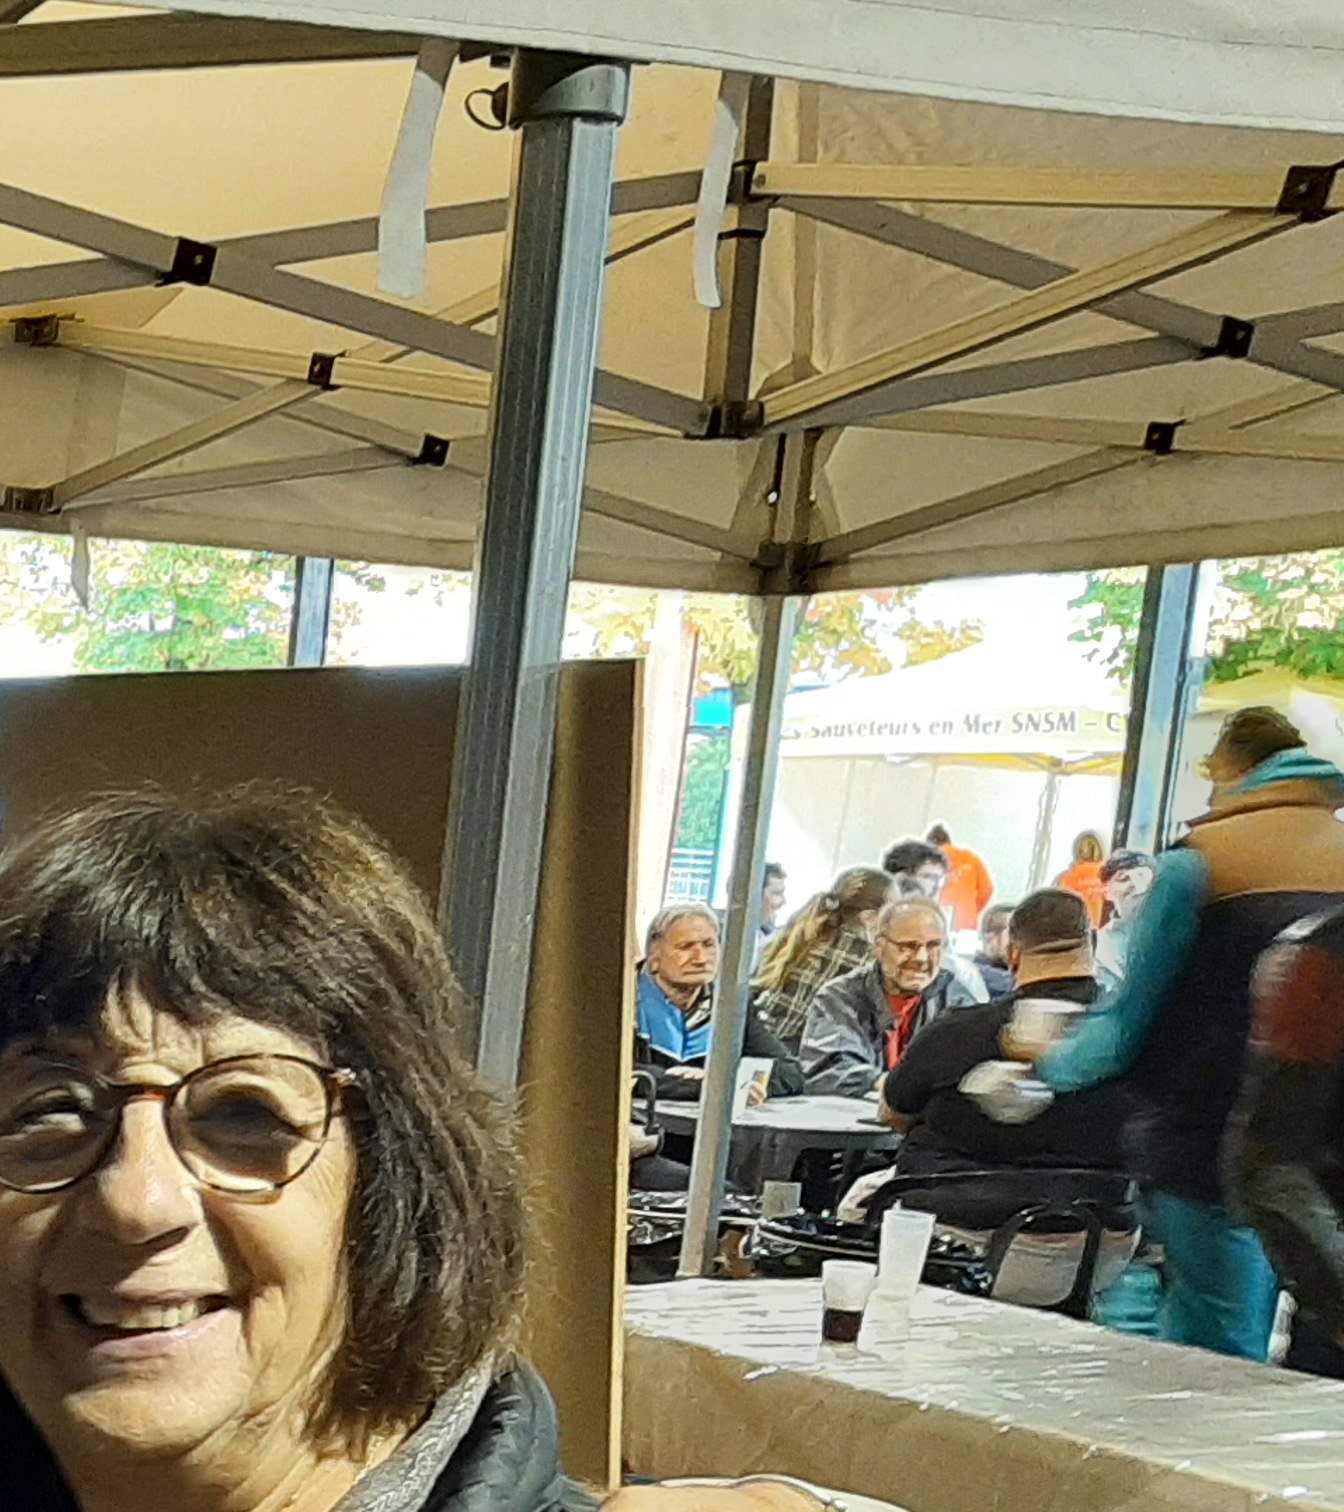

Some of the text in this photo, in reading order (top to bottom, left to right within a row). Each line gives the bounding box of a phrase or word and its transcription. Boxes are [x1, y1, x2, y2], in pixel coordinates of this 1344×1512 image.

[929, 720, 953, 736] en
[963, 713, 1002, 734] Mer
[1011, 711, 1076, 734] SNSM
[1106, 711, 1130, 733] C
